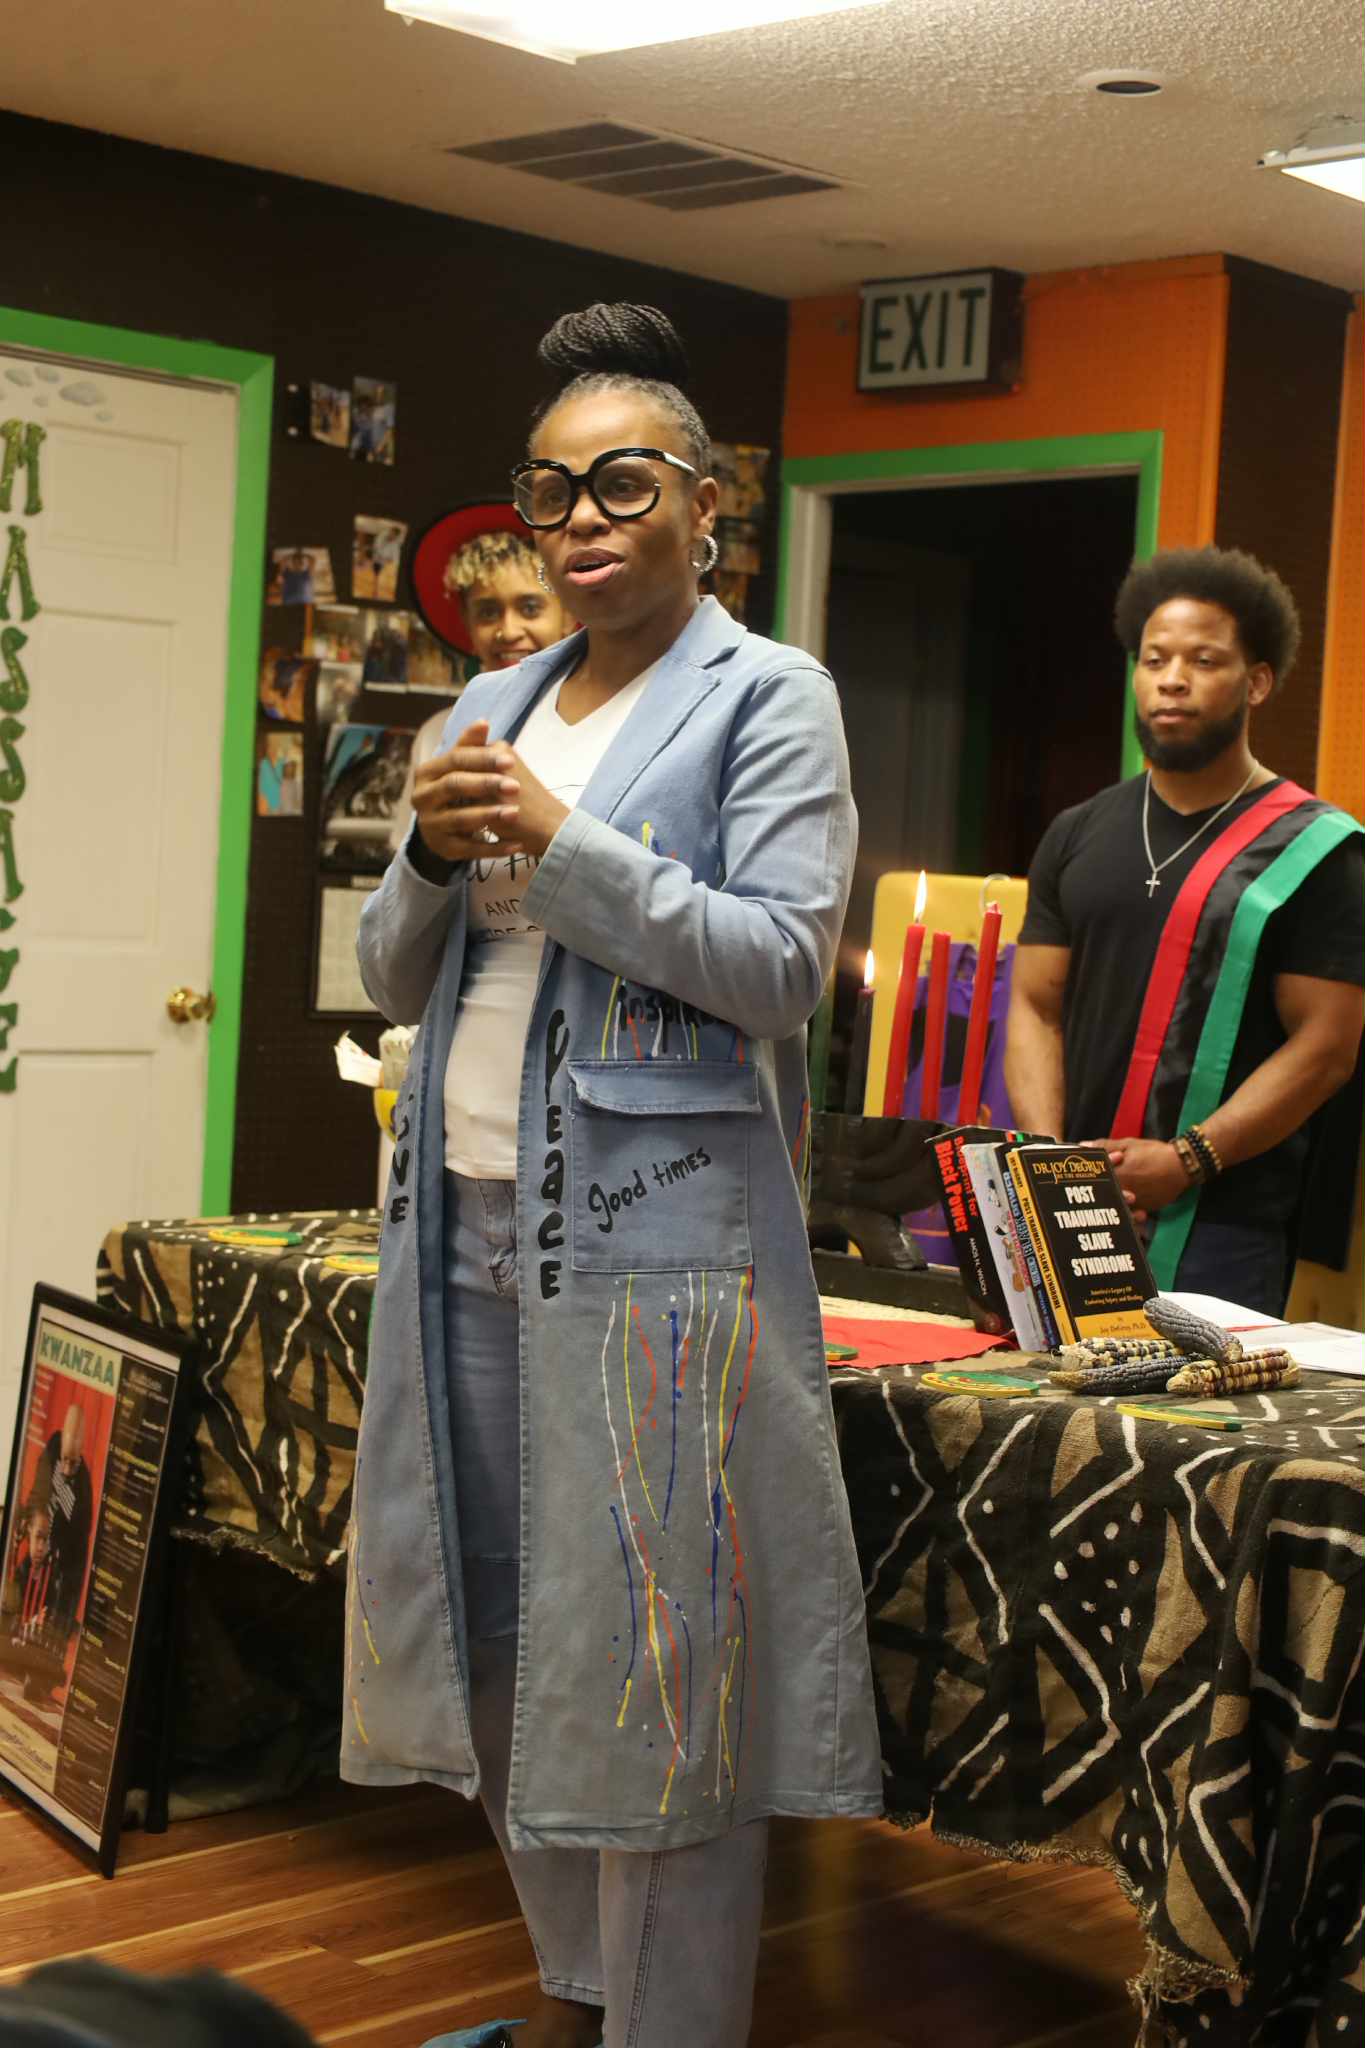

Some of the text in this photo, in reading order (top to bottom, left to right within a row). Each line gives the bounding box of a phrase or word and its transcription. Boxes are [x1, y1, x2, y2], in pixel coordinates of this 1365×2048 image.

[868, 288, 986, 374] EXIT
[935, 1140, 969, 1233] Black Power
[1065, 1185, 1096, 1204] POST
[1054, 1208, 1120, 1229] TRAUMATIC
[1077, 1231, 1115, 1251] SLAVE
[969, 1237, 979, 1258] AMOS
[977, 1268, 988, 1296] WILSON
[1021, 1197, 1032, 1214] POST
[1028, 1215, 1043, 1253] TRAUMATIC
[1039, 1252, 1049, 1272] SLAVE
[1045, 1271, 1062, 1309] SYNDROME
[1071, 1254, 1136, 1277] SYNDROME
[39, 1331, 116, 1389] KWANZAA
